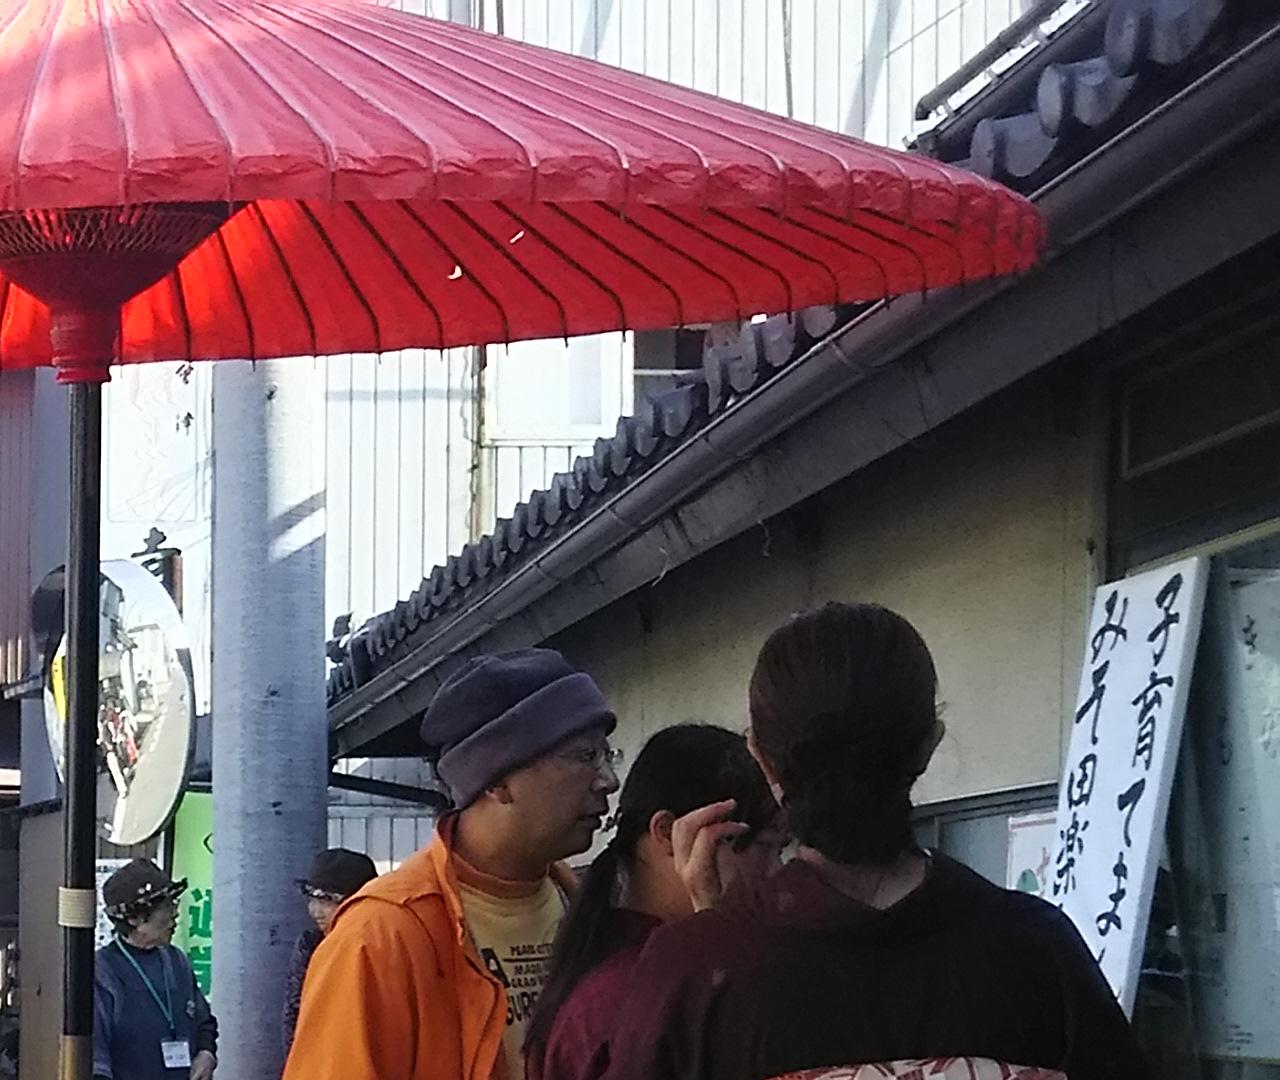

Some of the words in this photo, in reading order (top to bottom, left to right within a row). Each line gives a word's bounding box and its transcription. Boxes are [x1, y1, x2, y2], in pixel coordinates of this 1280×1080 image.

[1053, 589, 1128, 908] みそ田楽
[1096, 572, 1183, 966] 子育てま
